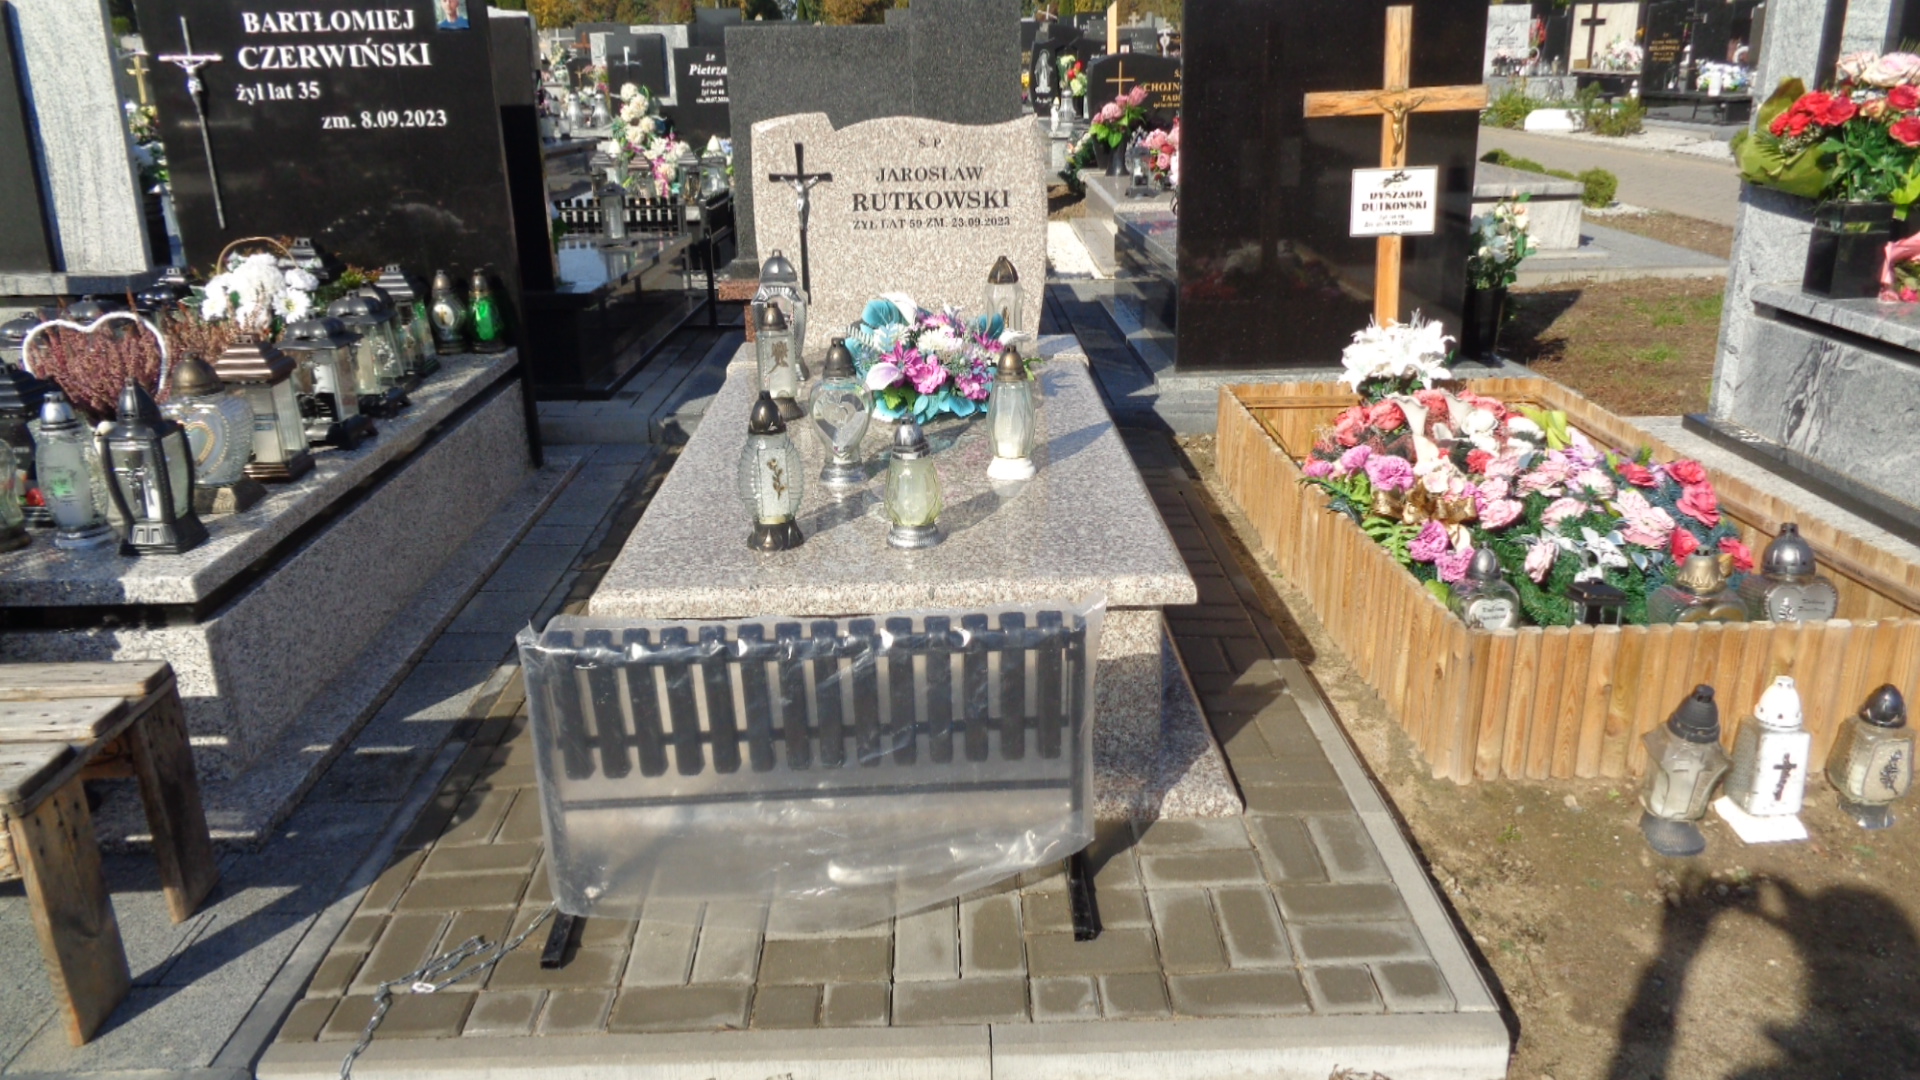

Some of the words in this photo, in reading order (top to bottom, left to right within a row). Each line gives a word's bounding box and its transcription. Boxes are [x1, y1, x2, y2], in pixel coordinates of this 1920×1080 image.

[242, 10, 414, 33] BARTŁOMIEJ
[238, 38, 431, 69] CZERWIŃSKI
[267, 82, 294, 100] lat
[297, 81, 321, 99] 35
[321, 114, 356, 129] zm.
[360, 109, 448, 129] 8.09.2023
[852, 190, 1010, 212] RUTKOWSKI
[881, 218, 906, 229] LAT
